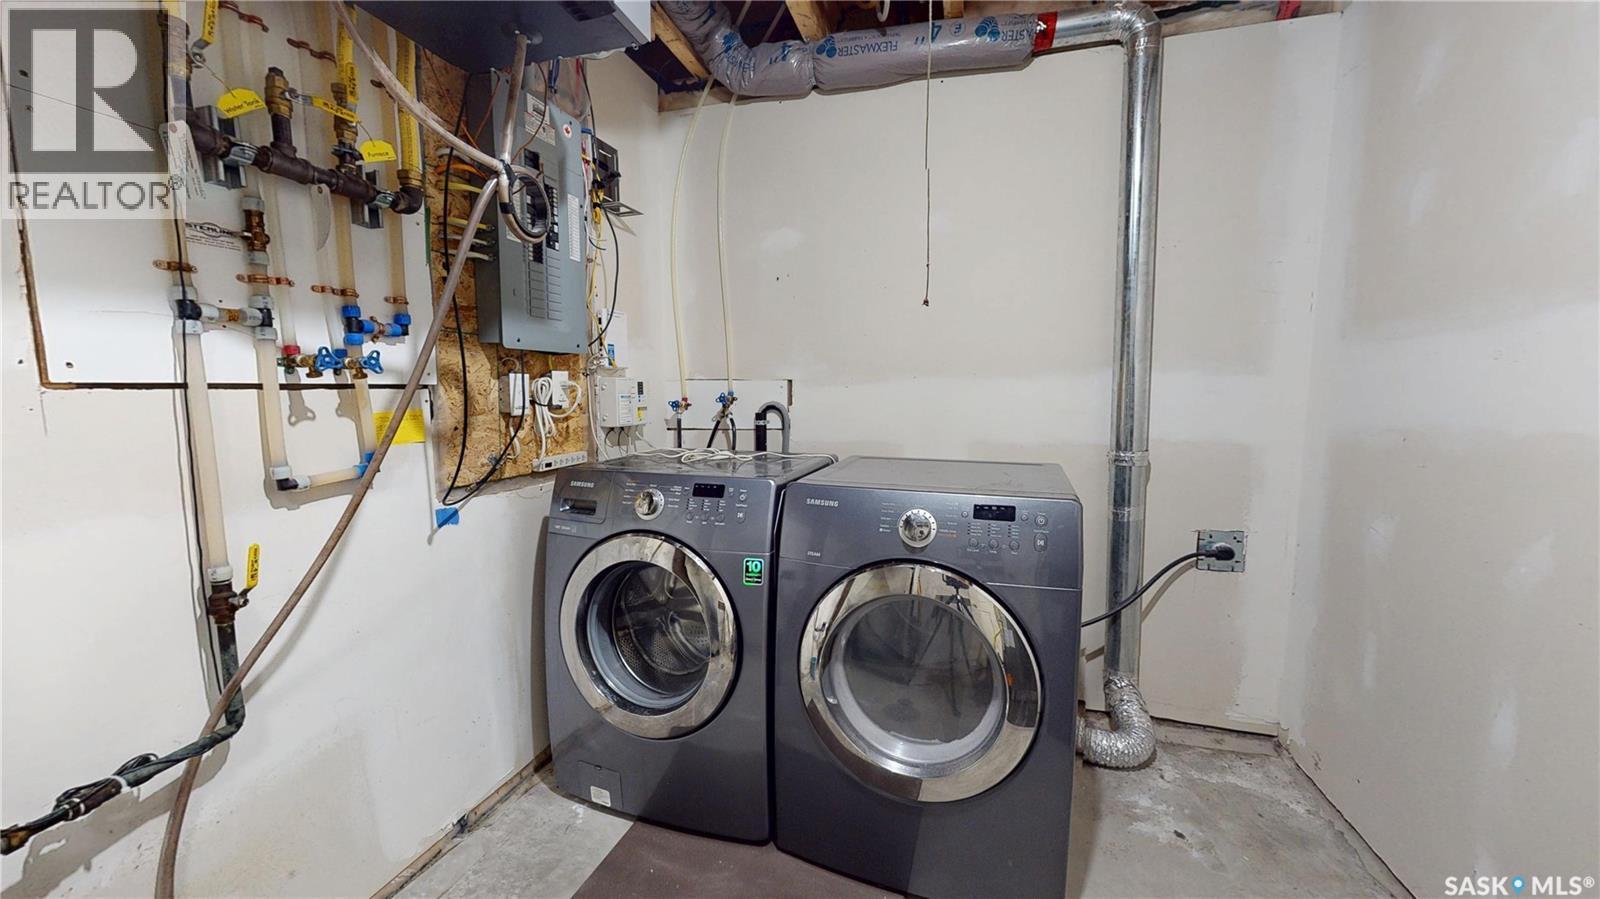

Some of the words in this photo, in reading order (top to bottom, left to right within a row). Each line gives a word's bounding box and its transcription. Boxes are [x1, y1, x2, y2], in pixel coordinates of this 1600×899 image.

[837, 40, 899, 57] FLEXMASTER
[570, 480, 595, 488] SAMSUNG
[806, 498, 839, 507] SAMSUNG
[746, 560, 762, 573] 10
